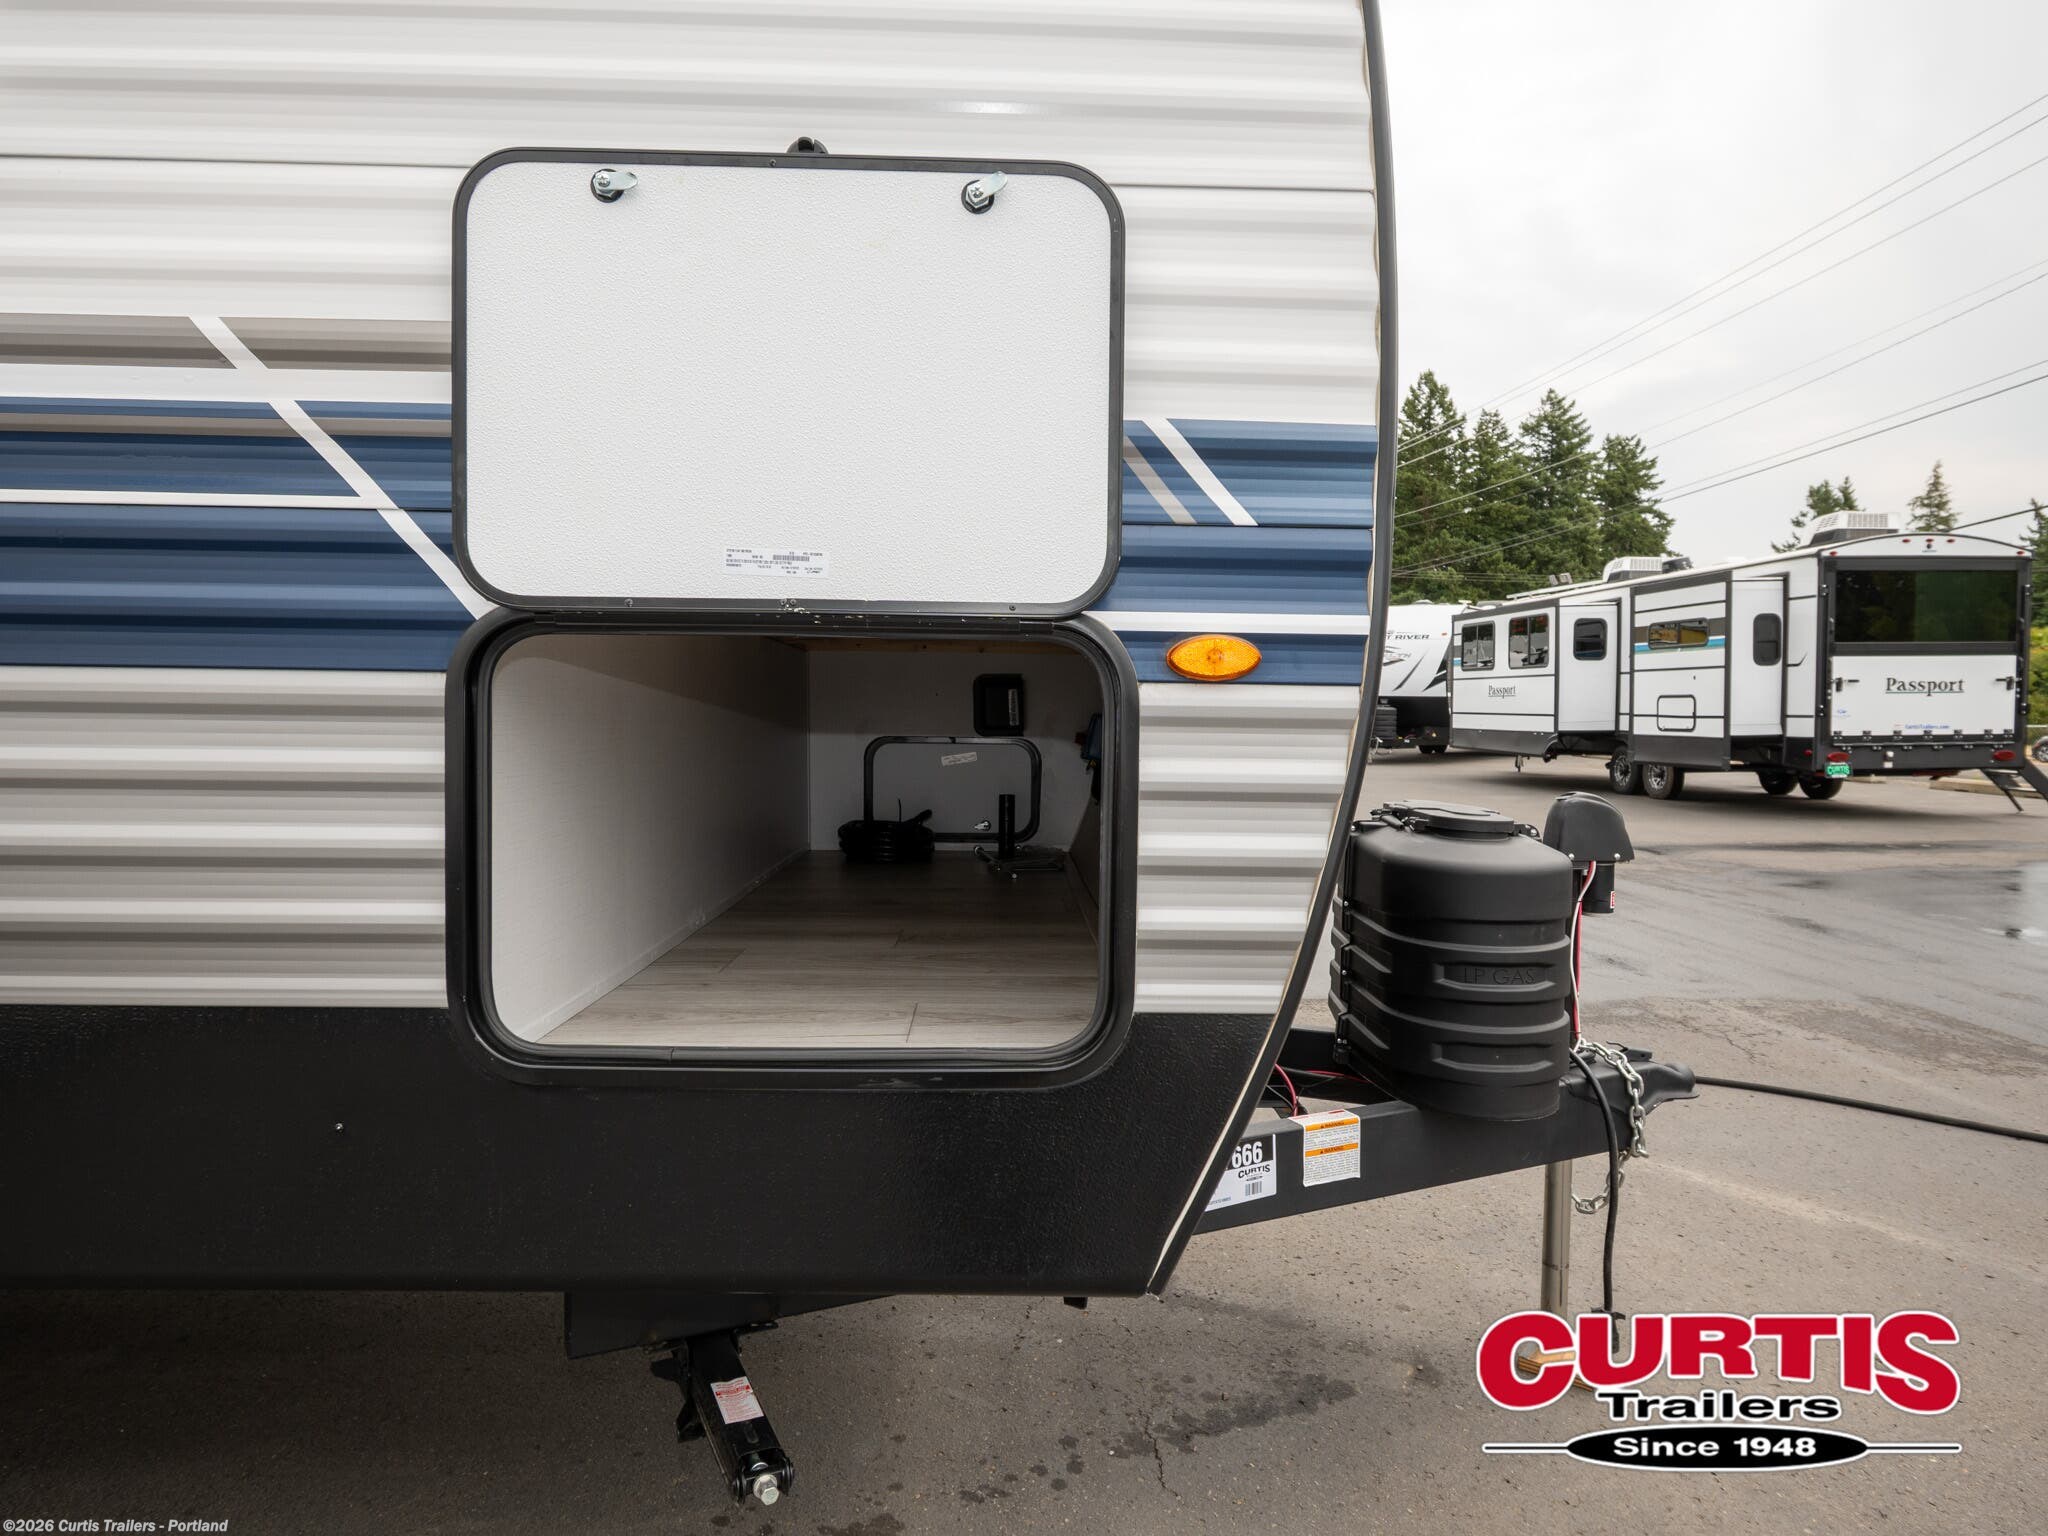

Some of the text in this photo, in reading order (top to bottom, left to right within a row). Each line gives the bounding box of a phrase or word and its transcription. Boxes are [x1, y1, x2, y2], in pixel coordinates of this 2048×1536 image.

[1488, 684, 1516, 699] Passport
[1886, 677, 1964, 697] Passport
[1464, 967, 1535, 985] LP GAS
[1238, 1164, 1271, 1179] CURTIS
